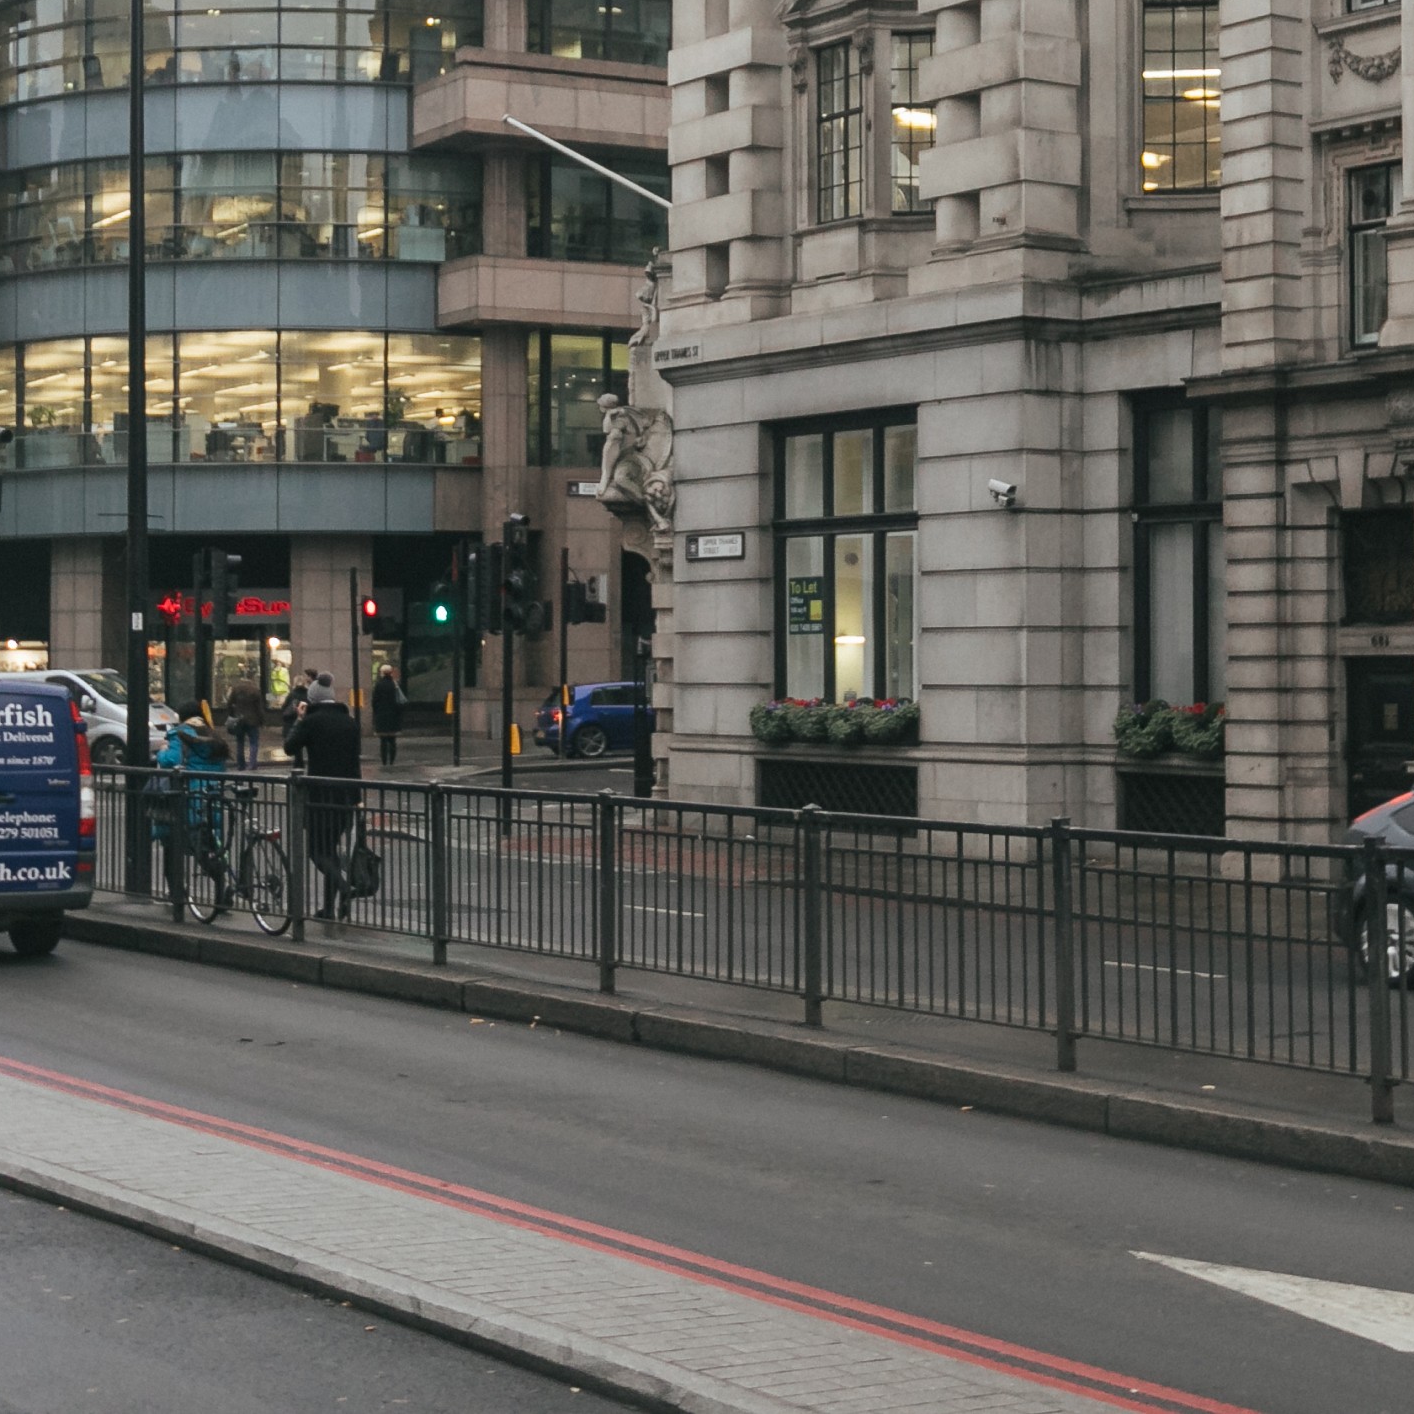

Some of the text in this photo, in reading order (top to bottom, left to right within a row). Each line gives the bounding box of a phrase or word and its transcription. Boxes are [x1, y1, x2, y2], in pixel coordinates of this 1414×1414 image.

[790, 581, 818, 594] To Let
[3, 732, 54, 743] Delivered
[7, 756, 31, 765] since
[20, 827, 59, 839] 501051
